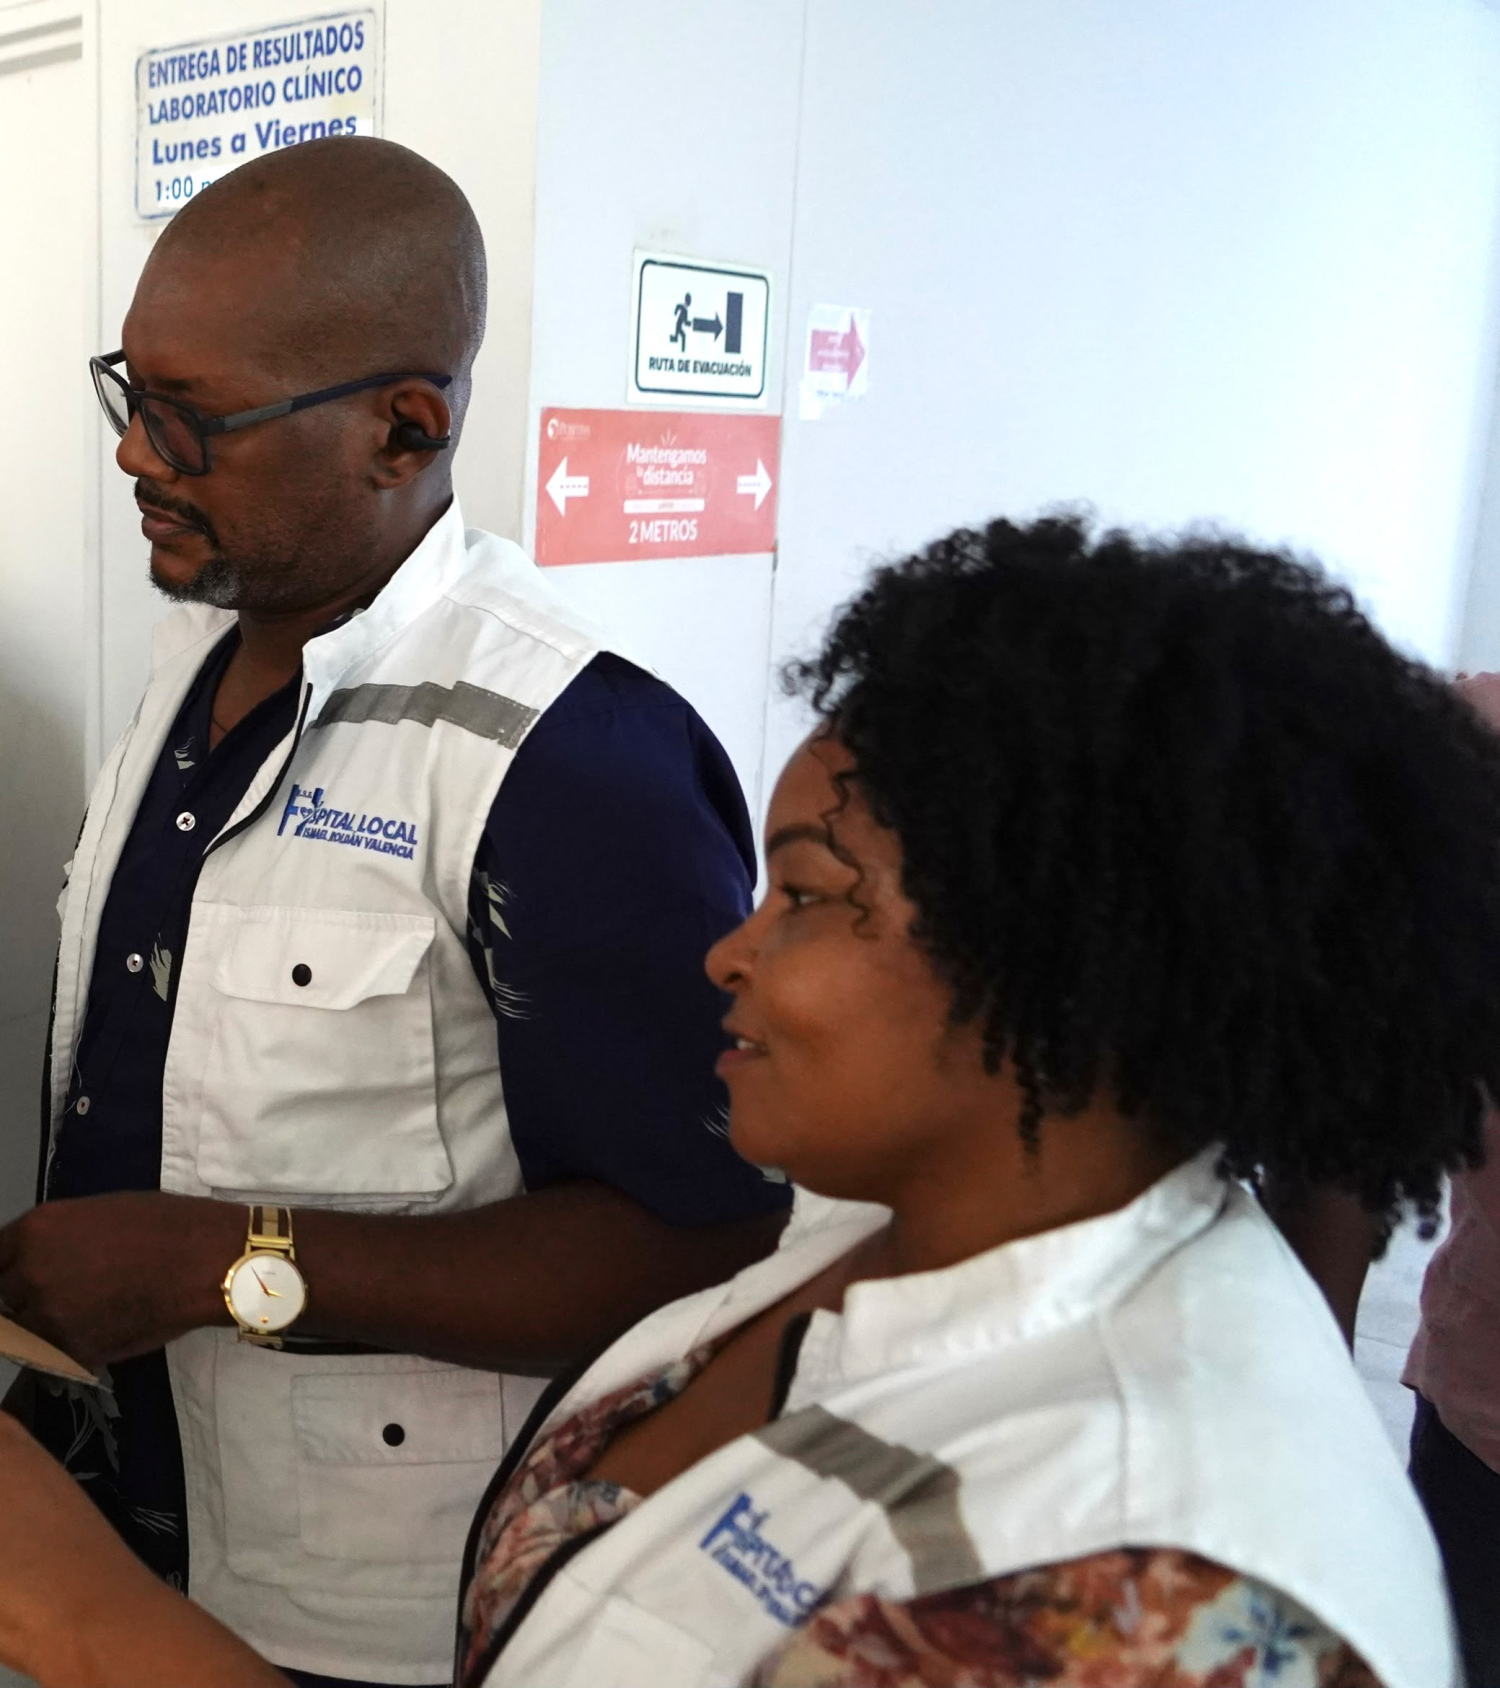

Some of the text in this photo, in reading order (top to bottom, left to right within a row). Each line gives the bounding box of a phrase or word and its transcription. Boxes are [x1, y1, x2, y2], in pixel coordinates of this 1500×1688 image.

[149, 20, 364, 88] ENTREGA DE RESULTADOS
[149, 65, 362, 125] LABORATORIO CLÍNICO
[153, 116, 357, 165] Lunes a Viernes
[155, 175, 193, 201] 1:00
[649, 356, 752, 377] RUTA DE EVACUACIÓN
[627, 443, 707, 469] Mantengamos
[643, 464, 694, 486] distancia
[628, 518, 698, 544] 2 METROS
[357, 814, 418, 845] LOCAL
[362, 836, 414, 860] VALENCIA
